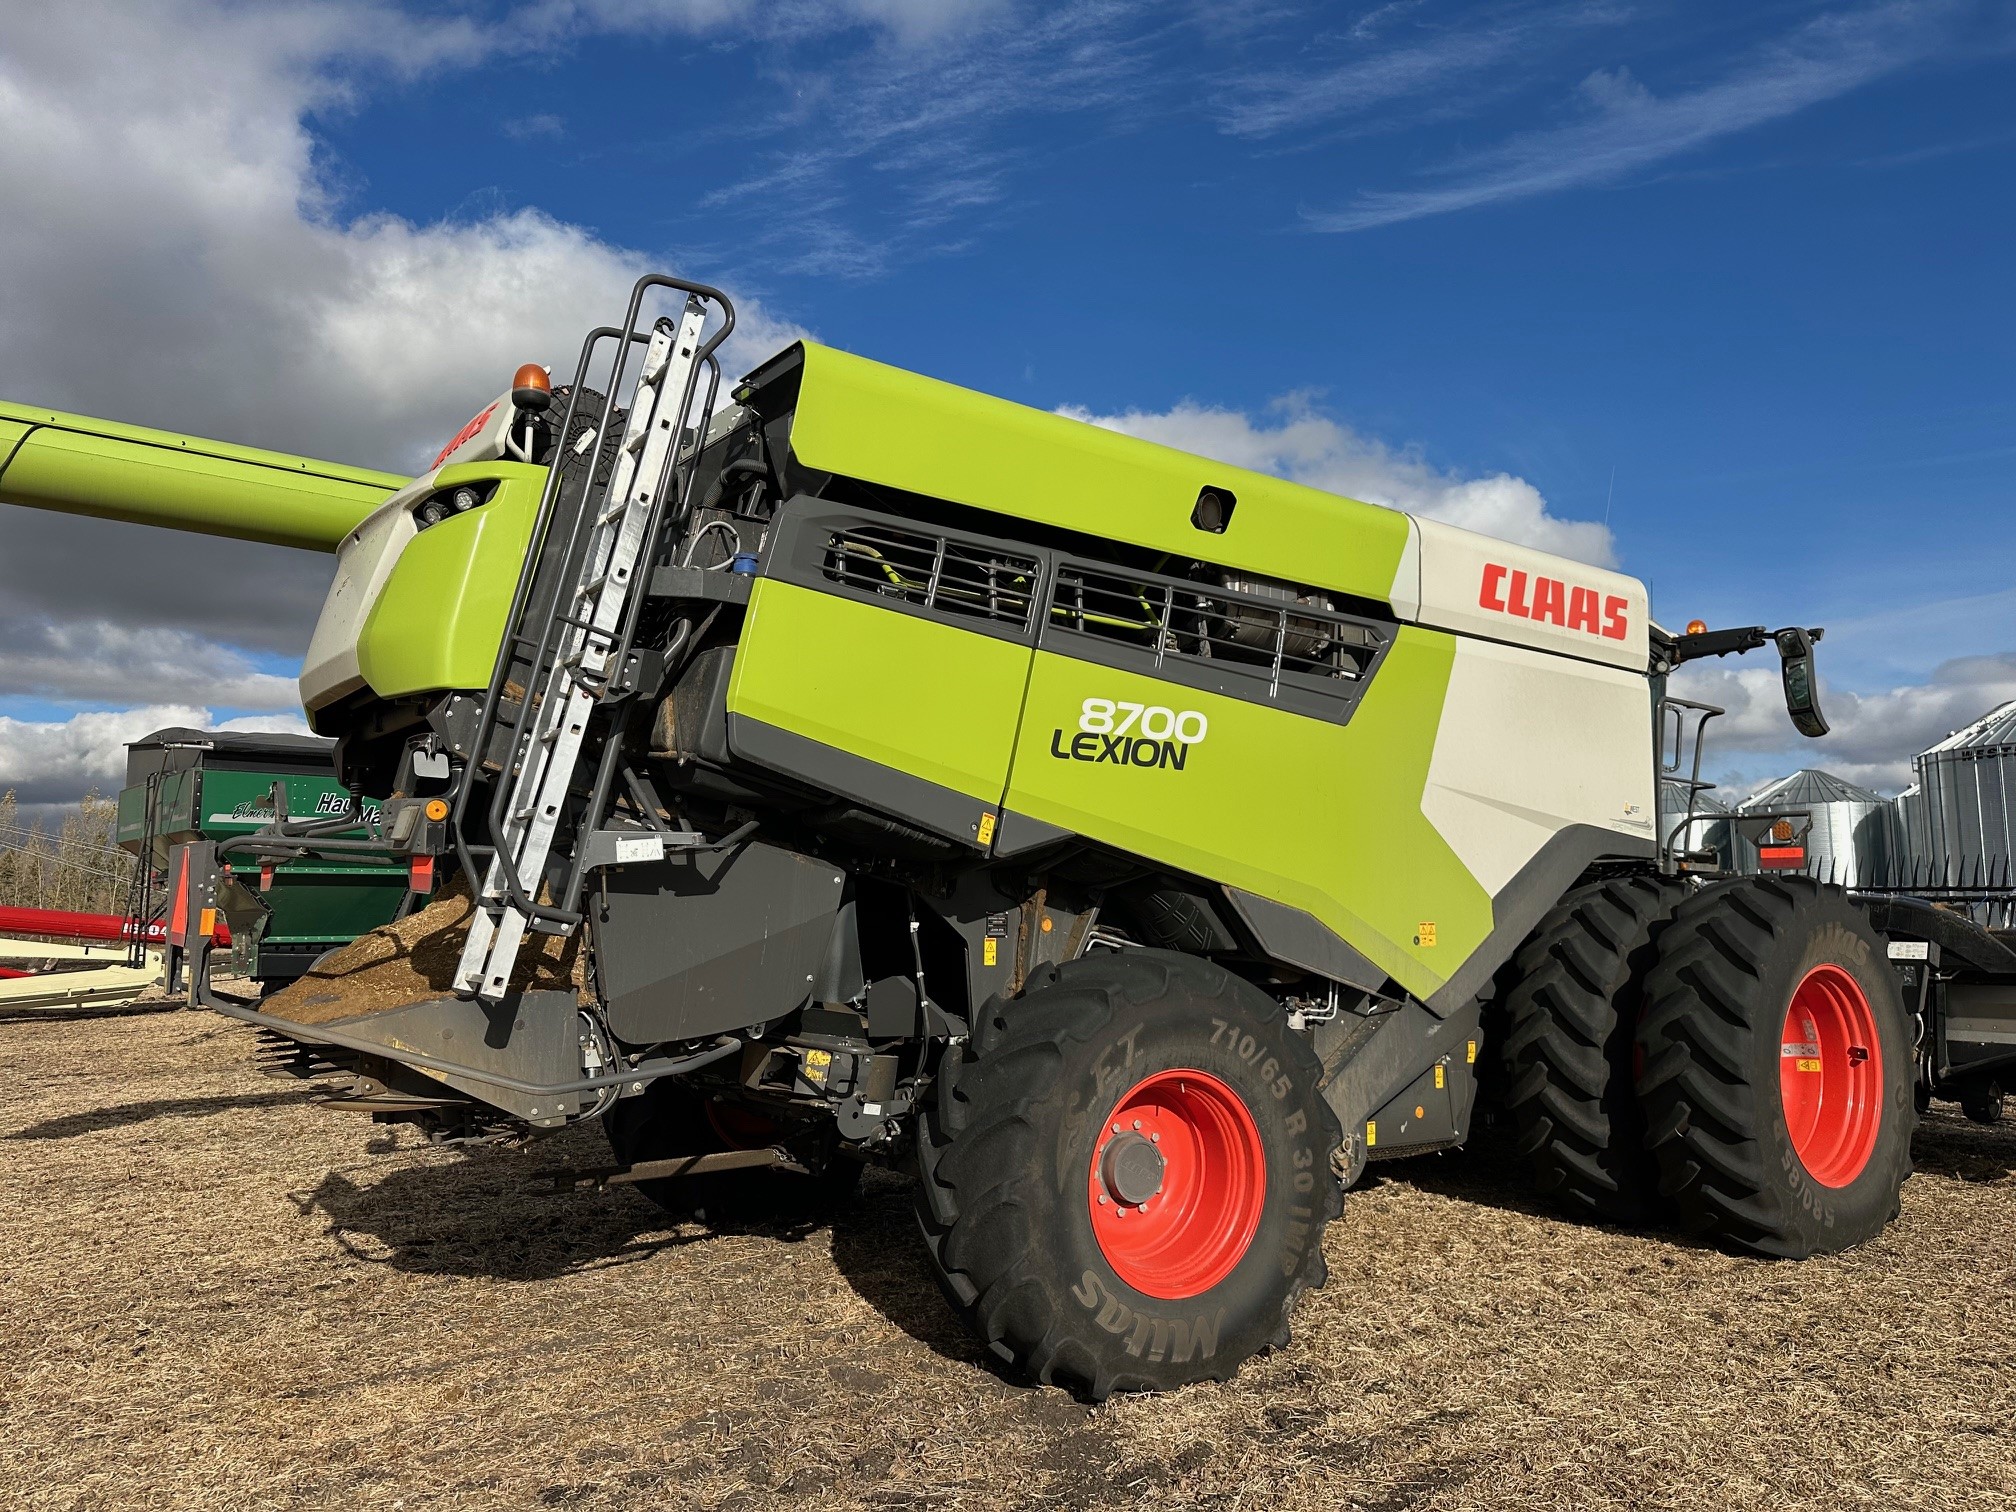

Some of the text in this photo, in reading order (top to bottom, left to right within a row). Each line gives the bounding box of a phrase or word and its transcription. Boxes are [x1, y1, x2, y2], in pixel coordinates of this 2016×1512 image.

[1479, 562, 1628, 641] CLAAS
[1078, 697, 1208, 744] 8700
[1050, 728, 1188, 771] LEXION
[1961, 746, 2016, 761] WEST
[314, 792, 355, 814] Hau
[1209, 1017, 1294, 1100] 710/65
[1284, 1108, 1307, 1138] R
[1292, 1146, 1314, 1193] 30
[1781, 1147, 1835, 1228] 580/85
[1071, 1269, 1227, 1363] Mitas
